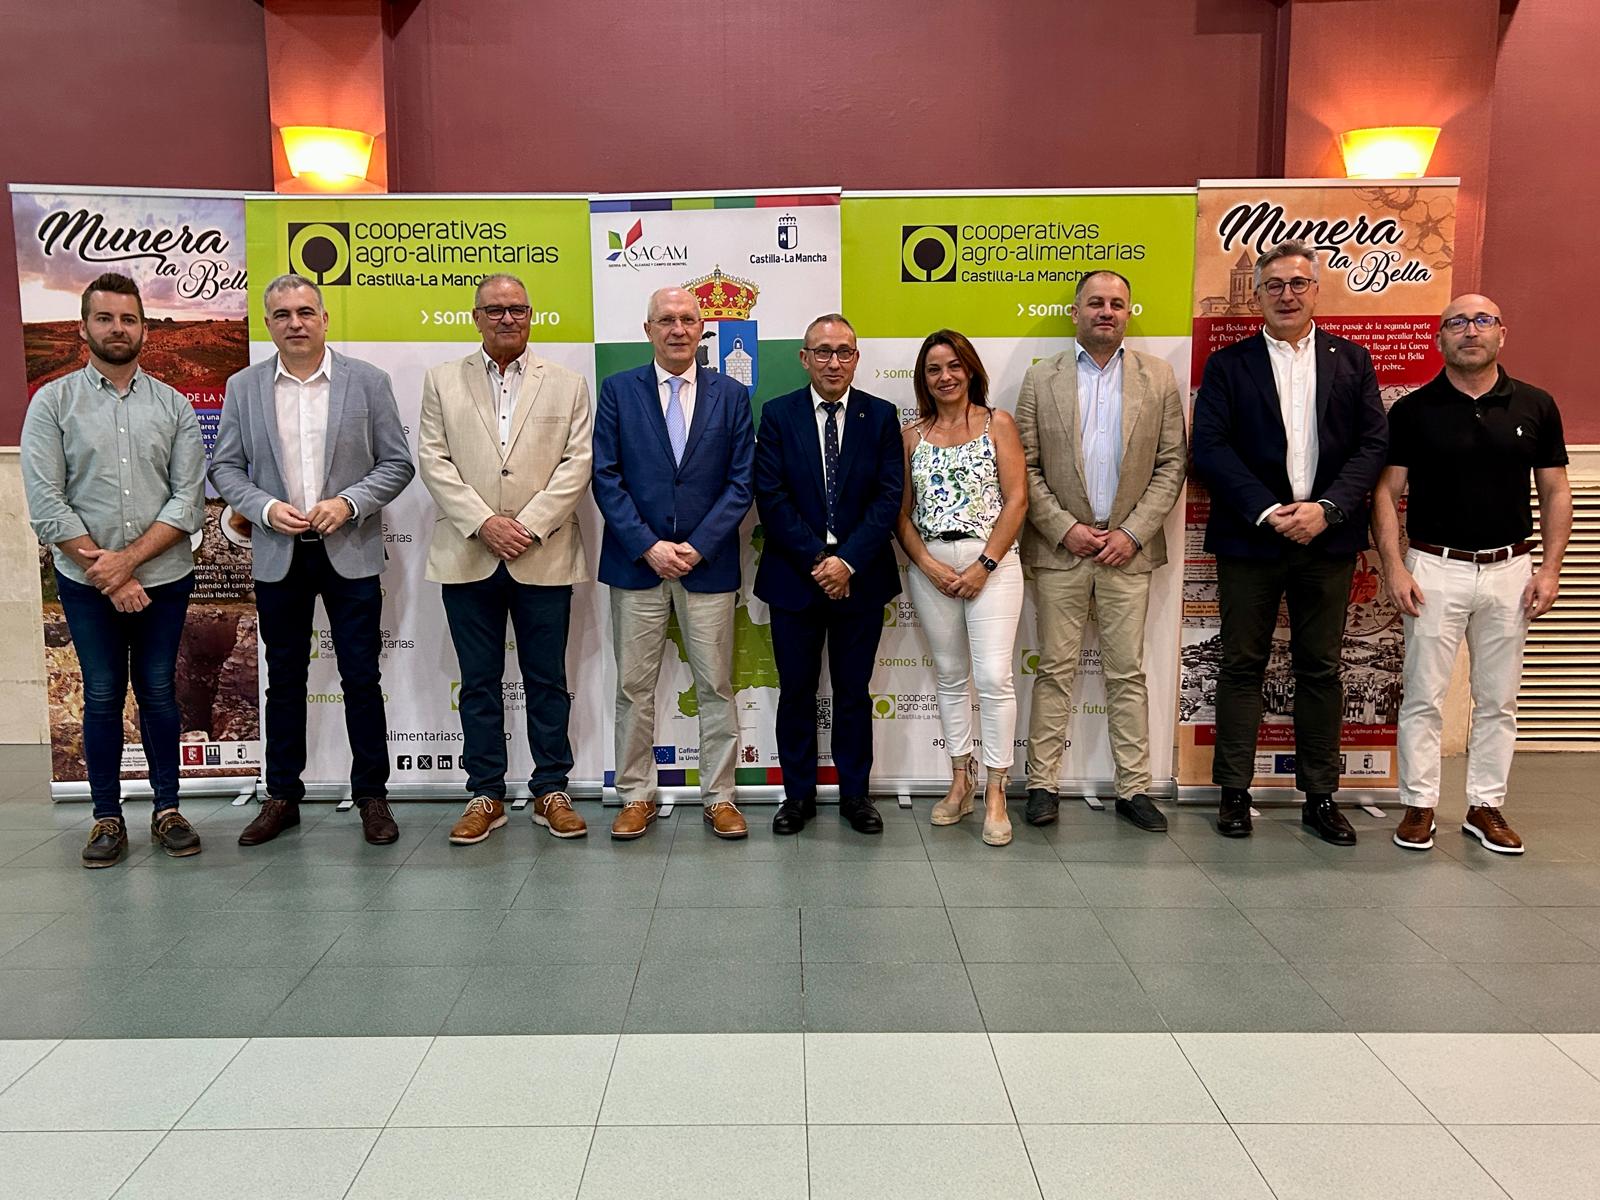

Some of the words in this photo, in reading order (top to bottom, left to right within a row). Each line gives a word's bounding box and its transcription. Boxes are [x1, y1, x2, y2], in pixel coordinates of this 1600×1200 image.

[355, 220, 507, 243] cooperativas
[962, 222, 1099, 242] cooperativas
[1219, 202, 1403, 254] Munera
[38, 209, 230, 263] Munera
[356, 243, 559, 268] agro-alimentarias
[629, 245, 687, 261] SACAM
[795, 253, 827, 262] Mancha
[961, 243, 1145, 266] agro-alimentarias
[155, 255, 181, 276] la
[1328, 252, 1352, 268] la
[1347, 251, 1432, 292] Bella
[357, 273, 438, 286] Castilla-La
[961, 271, 1034, 283] Castilla-La
[1028, 304, 1072, 316] somo
[433, 310, 473, 325] som
[1226, 323, 1248, 331] Bodas
[1342, 323, 1364, 332] pasaje
[1375, 322, 1381, 330] la
[1383, 323, 1411, 331] segunda
[1413, 322, 1431, 331] parte
[1386, 332, 1413, 341] peculiar
[1415, 332, 1432, 340] boda
[1373, 343, 1391, 351] llegar
[1408, 341, 1429, 350] Cueva
[1407, 352, 1425, 361] Bella
[883, 369, 915, 379] somo
[187, 393, 200, 402] DE
[203, 393, 216, 402] LA
[231, 583, 255, 591] campo
[879, 657, 917, 667] somos
[307, 694, 343, 703] omos
[897, 694, 936, 704] coopera
